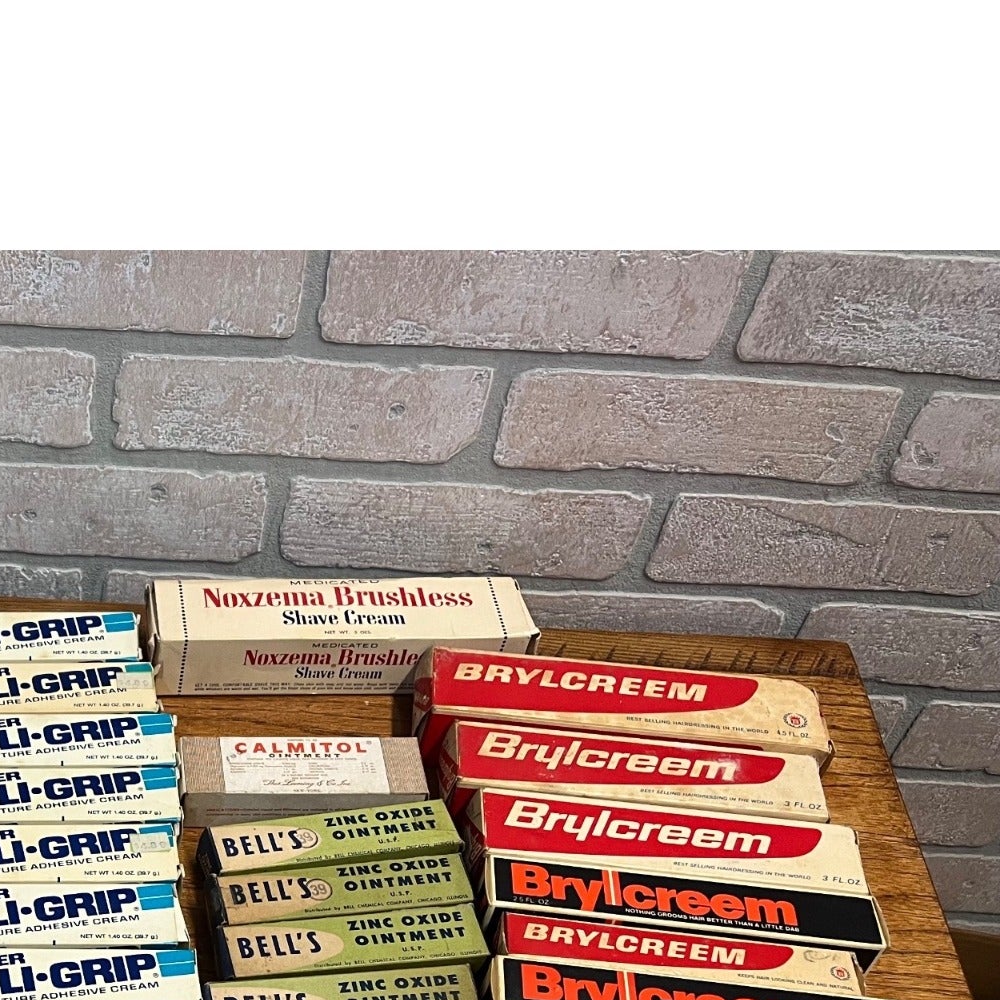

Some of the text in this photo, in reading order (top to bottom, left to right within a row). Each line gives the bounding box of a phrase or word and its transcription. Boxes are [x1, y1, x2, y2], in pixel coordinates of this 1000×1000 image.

[203, 586, 473, 609] Noxzema Brushless
[282, 609, 406, 626] Shave Cream
[453, 663, 707, 702] BRYLCREEM
[234, 740, 368, 754] CALMITOL
[477, 732, 738, 781] Brylcreem
[324, 814, 368, 827] ZINC
[375, 806, 434, 820] OXIDE
[504, 800, 771, 855] Brylcreem
[332, 820, 437, 840] OINTMENT
[222, 830, 301, 858] BELL'S
[336, 858, 450, 877] ZINC OXIDE
[229, 878, 311, 906] BELL'S
[344, 872, 452, 892] OINTMENT
[510, 862, 799, 927] Brylcreem
[346, 912, 463, 931] ZINC OXIDE
[236, 931, 322, 958] BELL'S
[354, 926, 466, 946] OINTMENT
[523, 923, 746, 965] BRYLCREEM
[338, 974, 459, 993] ZINC OXIDE
